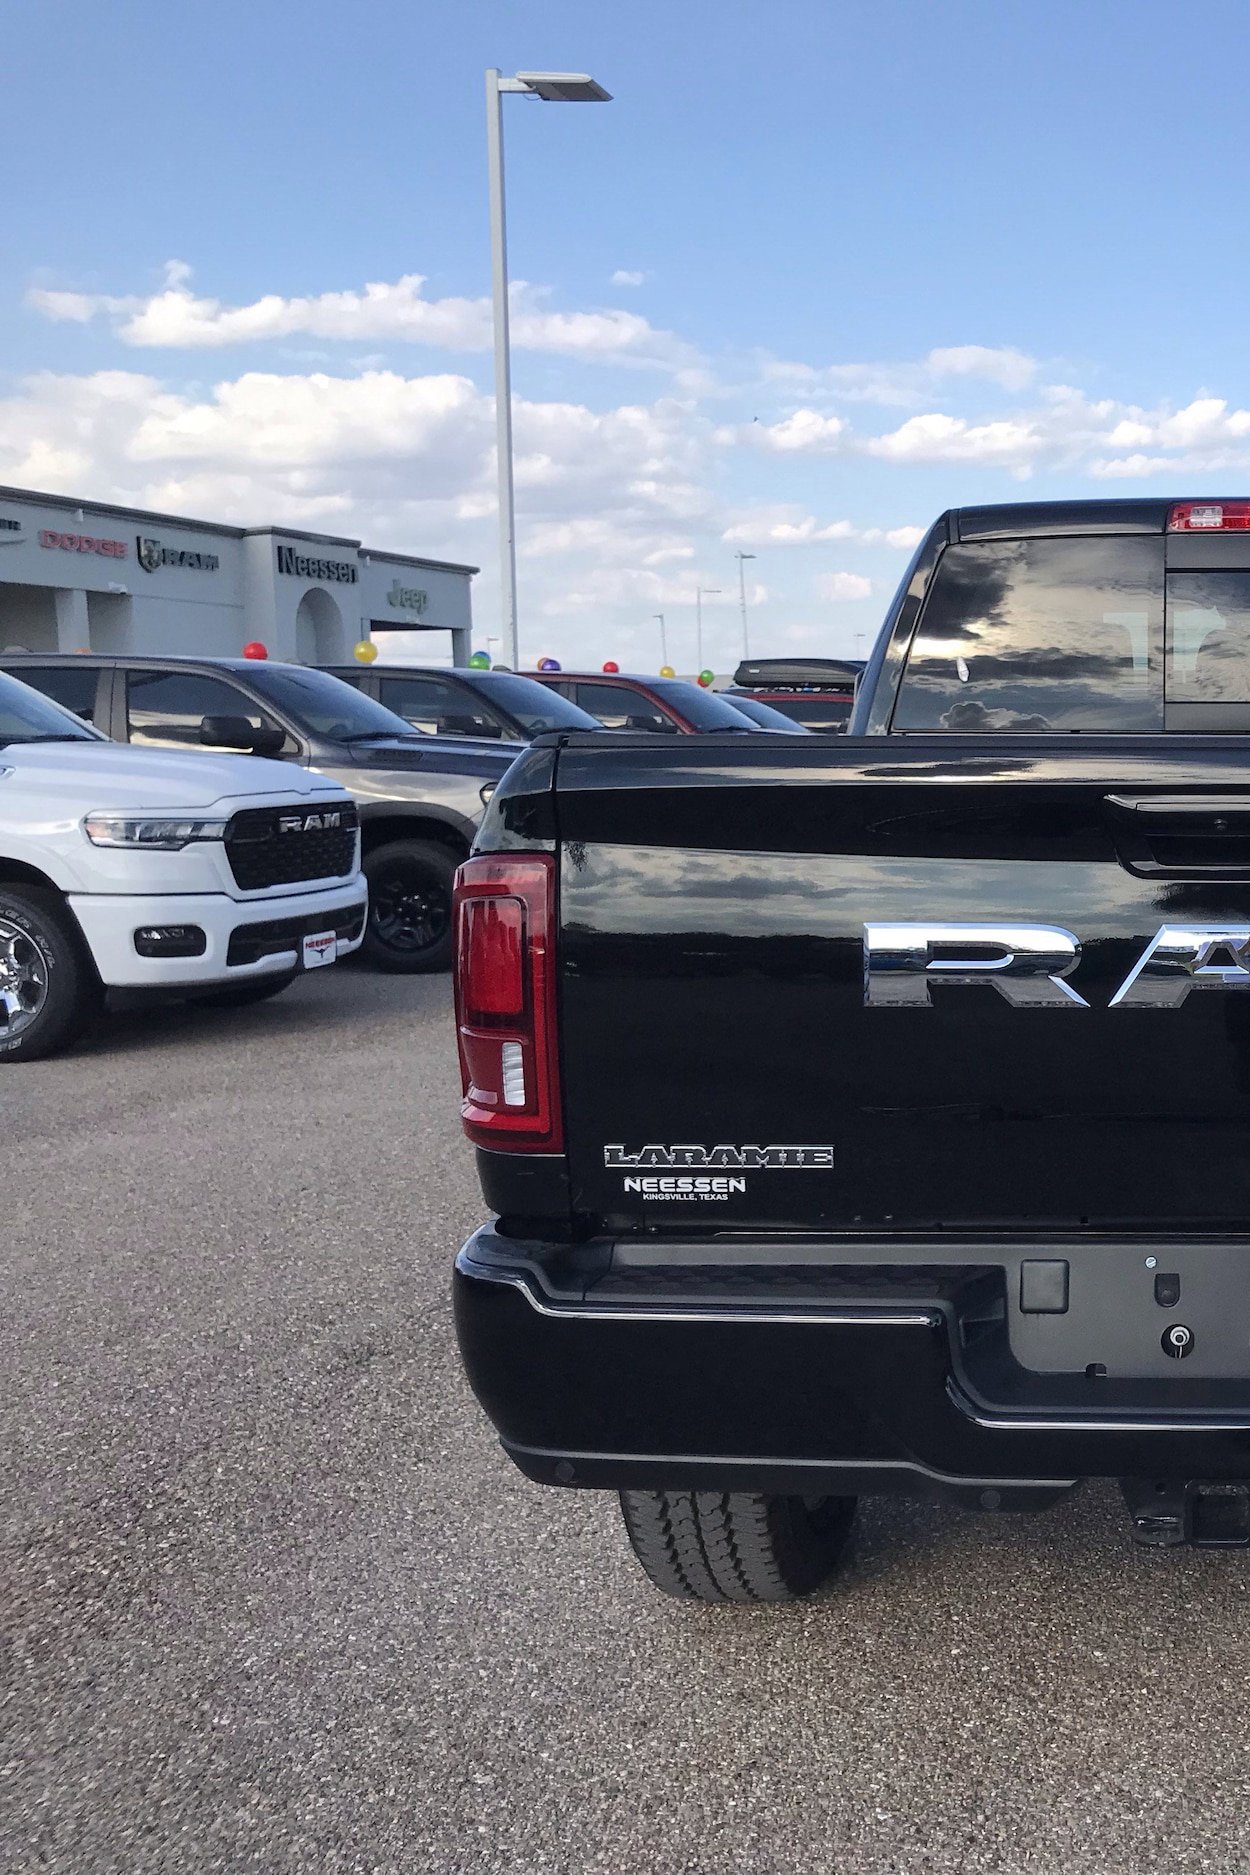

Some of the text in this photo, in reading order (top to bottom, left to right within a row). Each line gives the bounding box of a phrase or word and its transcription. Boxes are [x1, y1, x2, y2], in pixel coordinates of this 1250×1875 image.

[40, 529, 129, 559] DODGE
[162, 549, 219, 571] RAM
[277, 545, 359, 583] Neessen
[386, 579, 429, 614] Jeep
[279, 812, 341, 833] RAM
[604, 1143, 834, 1169] LARAMIE
[623, 1178, 746, 1193] NEESSEN
[642, 1193, 698, 1201] KINGSVILLE,
